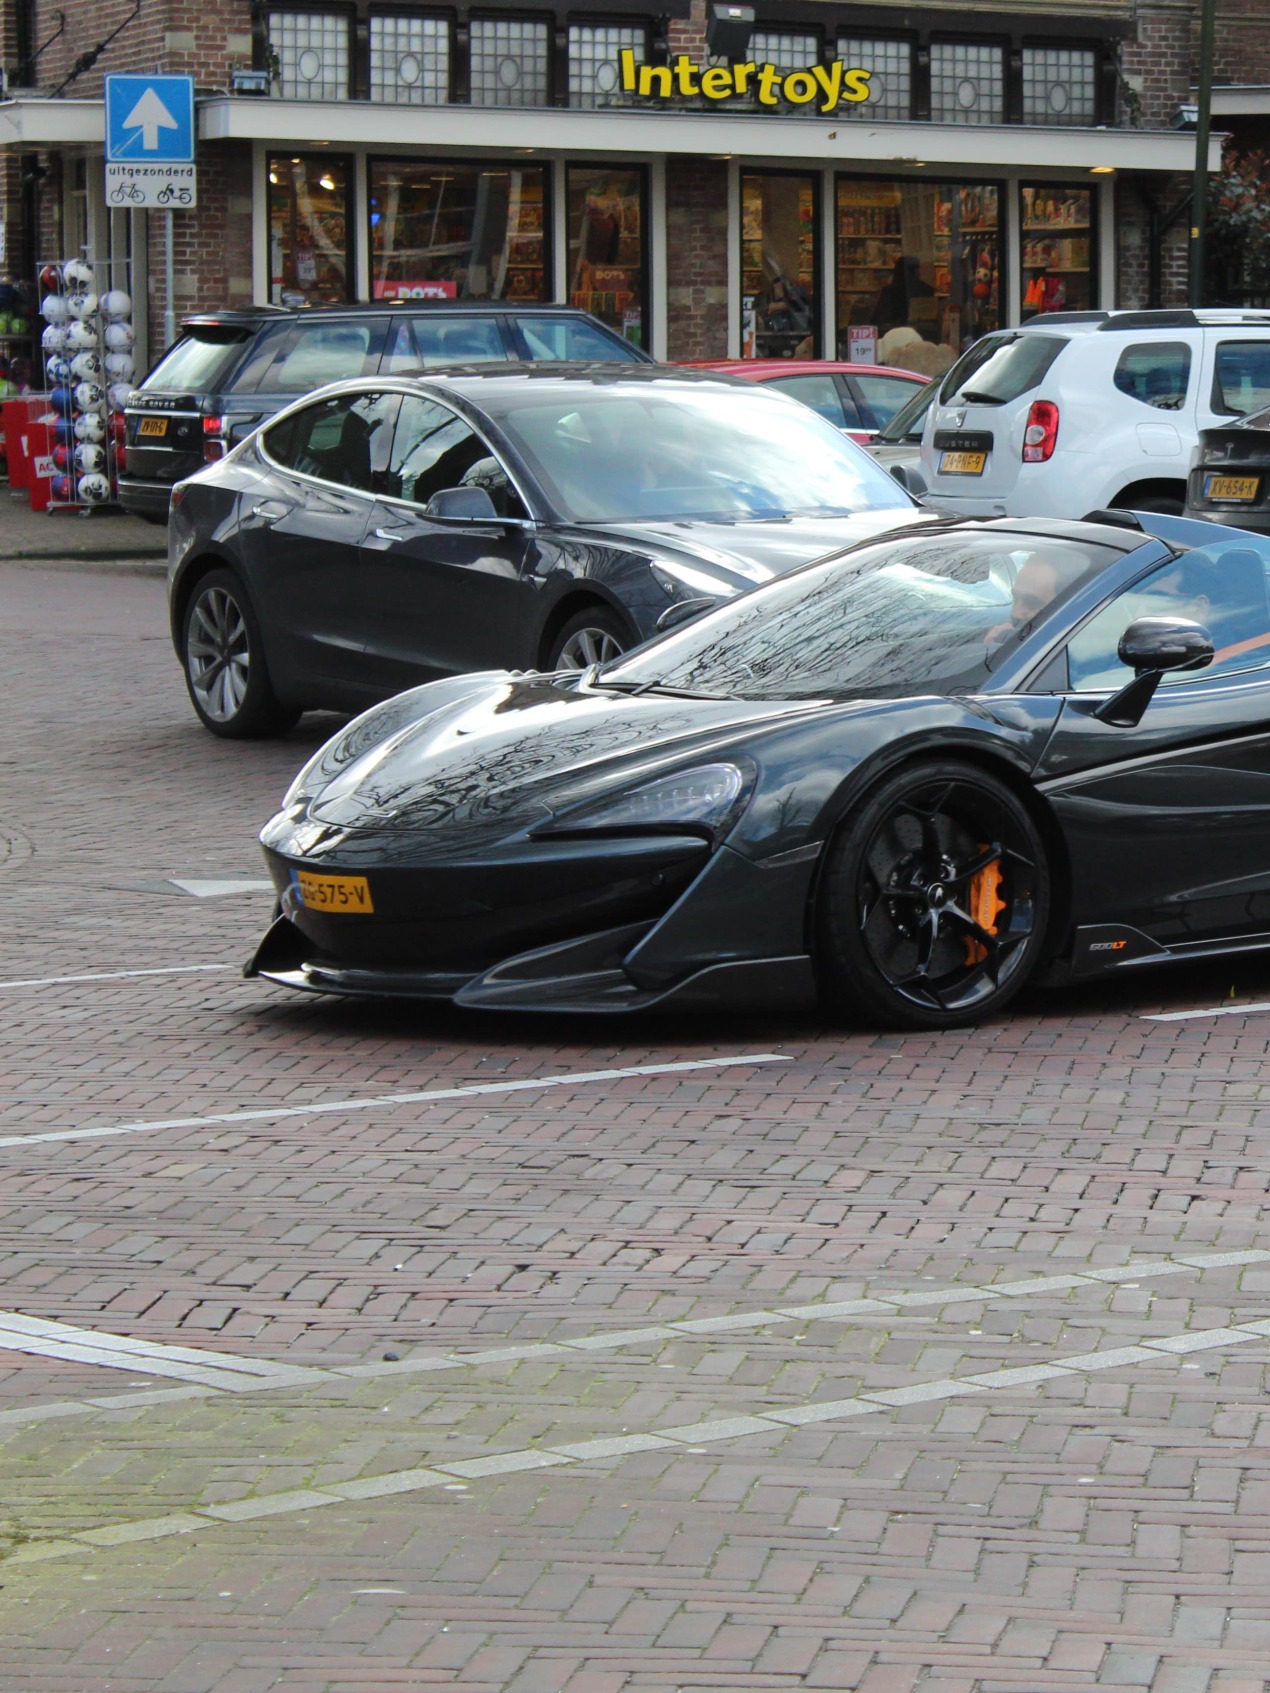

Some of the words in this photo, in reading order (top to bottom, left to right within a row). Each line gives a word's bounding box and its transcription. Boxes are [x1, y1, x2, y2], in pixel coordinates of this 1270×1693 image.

[618, 49, 872, 112] Intertoys
[108, 166, 193, 178] uitgezonderd
[851, 327, 873, 338] TIP!
[943, 454, 981, 470] 74-PNF-9
[1210, 479, 1255, 496] XV-654-K
[1089, 941, 1128, 951] 600LT
